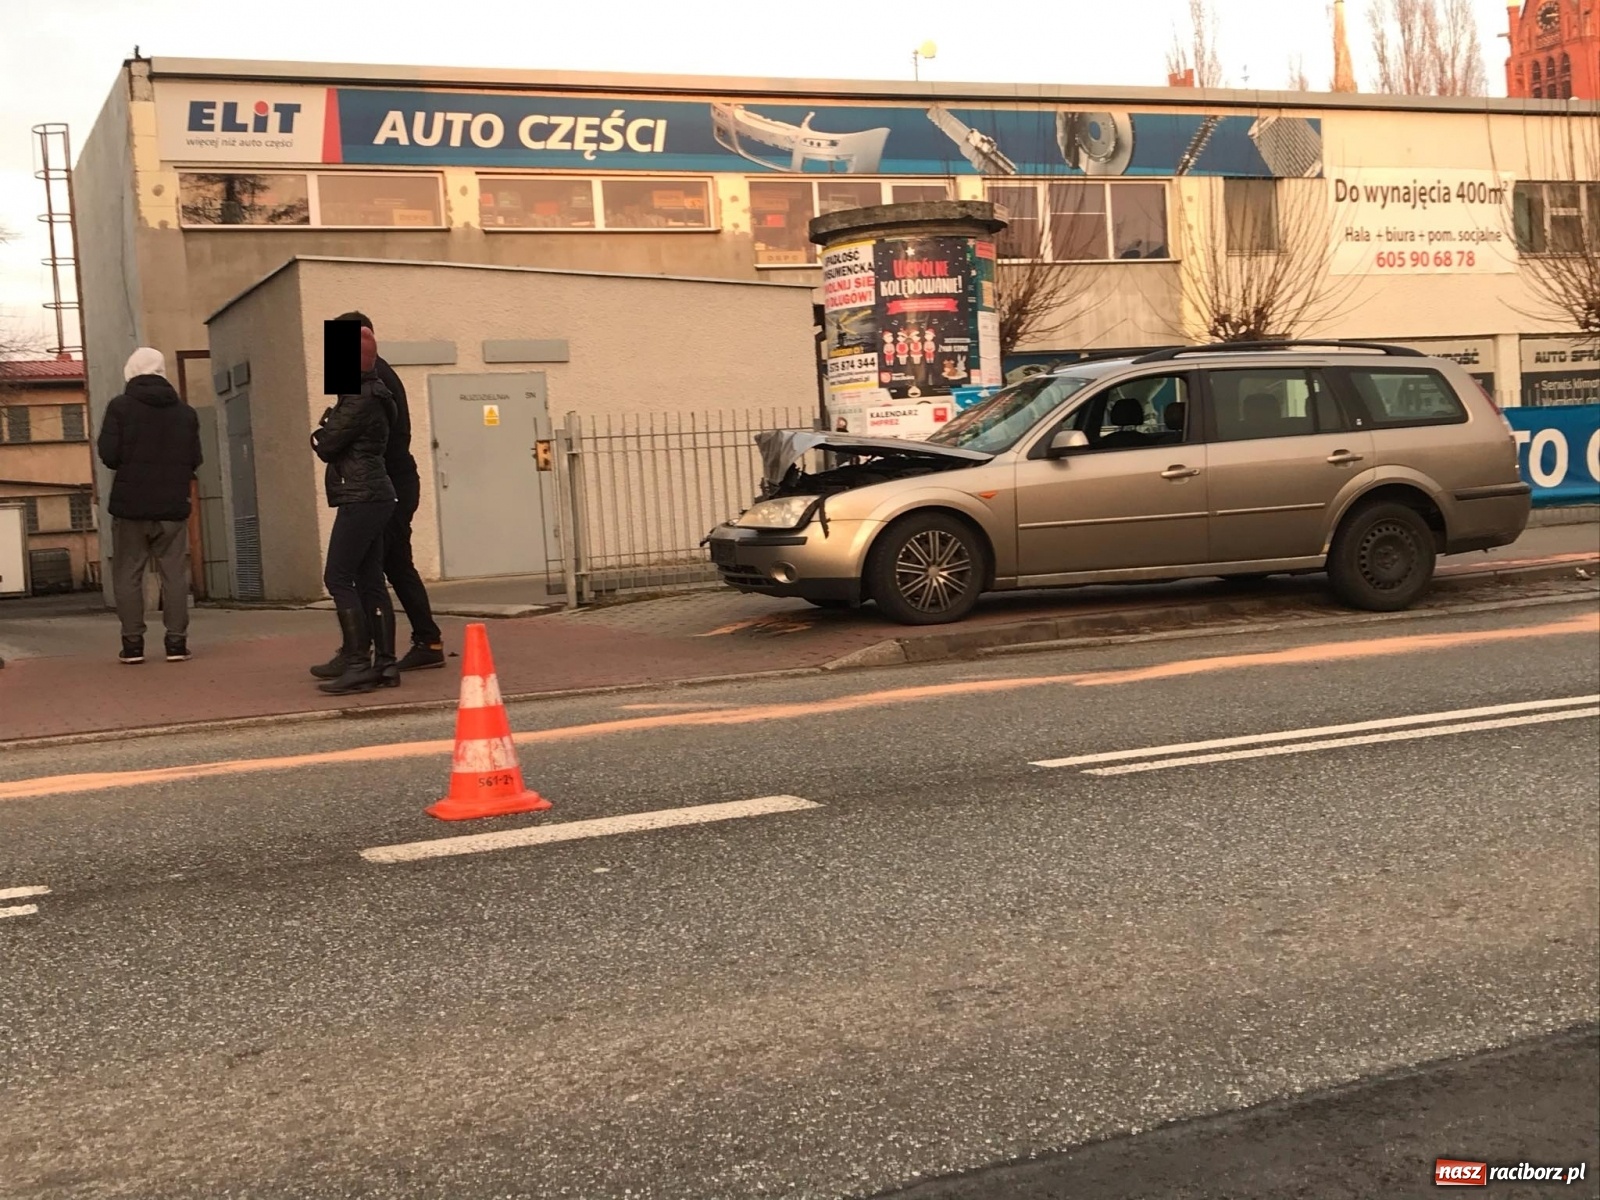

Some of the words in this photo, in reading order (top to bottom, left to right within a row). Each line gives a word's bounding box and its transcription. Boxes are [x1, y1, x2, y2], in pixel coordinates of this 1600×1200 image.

[186, 137, 219, 148] więcej
[221, 138, 237, 147] niż
[239, 139, 263, 147] auto
[264, 139, 293, 149] części
[372, 110, 505, 149] AUTO
[518, 109, 667, 161] CZĘŚCI
[1335, 179, 1359, 203] Do
[1363, 180, 1451, 209] wynajęcia
[1345, 228, 1371, 242] Hala
[1385, 227, 1415, 242] biura
[1428, 230, 1456, 245] pom.
[1459, 228, 1502, 245] socjalne
[1376, 252, 1406, 267] 605
[1410, 252, 1430, 267] 90
[1433, 251, 1453, 267] 68
[1457, 251, 1476, 267] 78
[893, 258, 949, 278] WSPÓLNE
[880, 275, 963, 298] KOLĘDOWANIE!
[857, 358, 876, 368] 344
[1535, 351, 1567, 363] AUTO
[1541, 379, 1572, 391] Serwis
[870, 409, 919, 418] KALENDARZ
